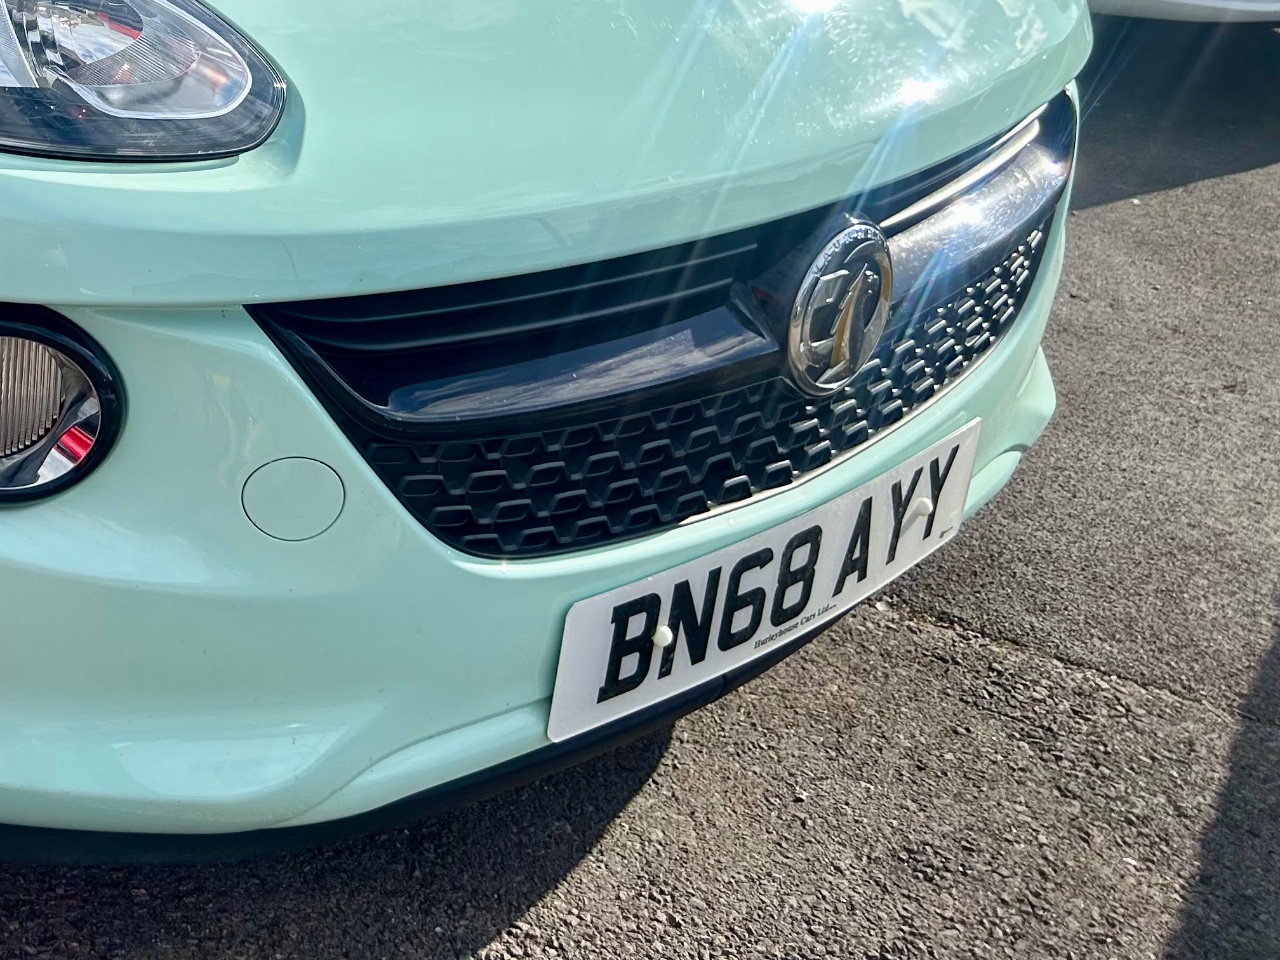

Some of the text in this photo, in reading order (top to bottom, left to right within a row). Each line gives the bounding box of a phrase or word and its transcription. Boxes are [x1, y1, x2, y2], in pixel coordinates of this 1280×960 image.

[597, 443, 960, 704] BN68 AYY
[800, 612, 817, 626] Cars
